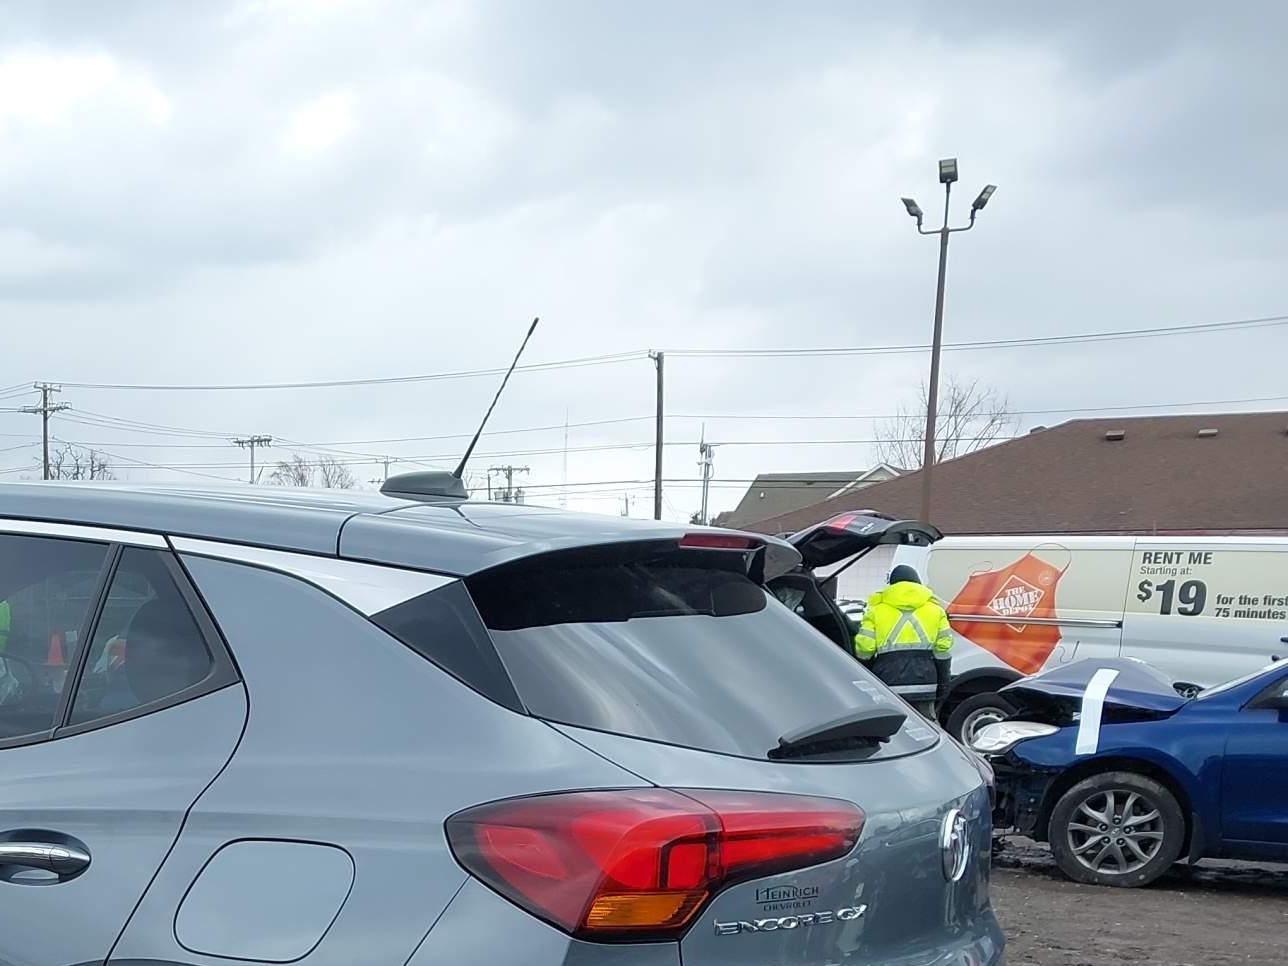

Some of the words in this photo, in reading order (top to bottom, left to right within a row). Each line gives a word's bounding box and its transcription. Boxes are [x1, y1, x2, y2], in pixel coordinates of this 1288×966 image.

[1142, 551, 1184, 565] RENT
[1188, 552, 1213, 565] ME
[1140, 566, 1177, 577] Starting
[1180, 567, 1193, 575] at:
[993, 591, 1038, 610] HOME
[1137, 578, 1207, 616] $19
[1216, 594, 1234, 605] for
[1238, 595, 1259, 606] the
[1215, 608, 1230, 618] 75
[1234, 608, 1286, 620] minutes
[756, 885, 819, 902] HEINRICH
[714, 910, 834, 936] ENCORE
[836, 904, 868, 921] GX
